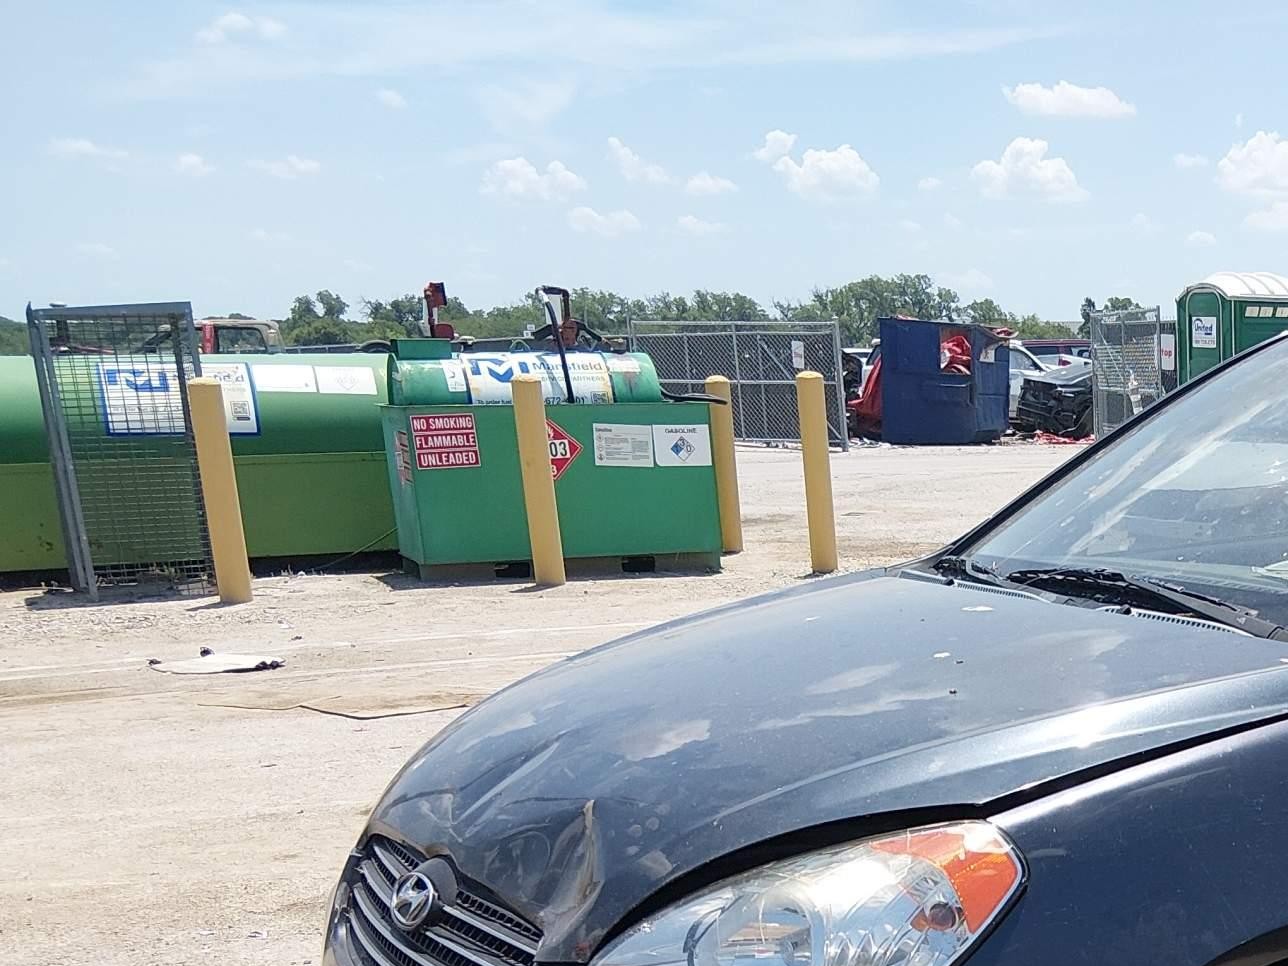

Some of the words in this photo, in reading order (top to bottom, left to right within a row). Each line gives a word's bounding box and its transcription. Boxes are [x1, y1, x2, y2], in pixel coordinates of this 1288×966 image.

[413, 418, 427, 431] NO
[429, 416, 473, 429] SMOKING
[415, 433, 476, 449] FLAMMABLE
[550, 441, 569, 457] 03
[420, 452, 477, 467] UNLEADED
